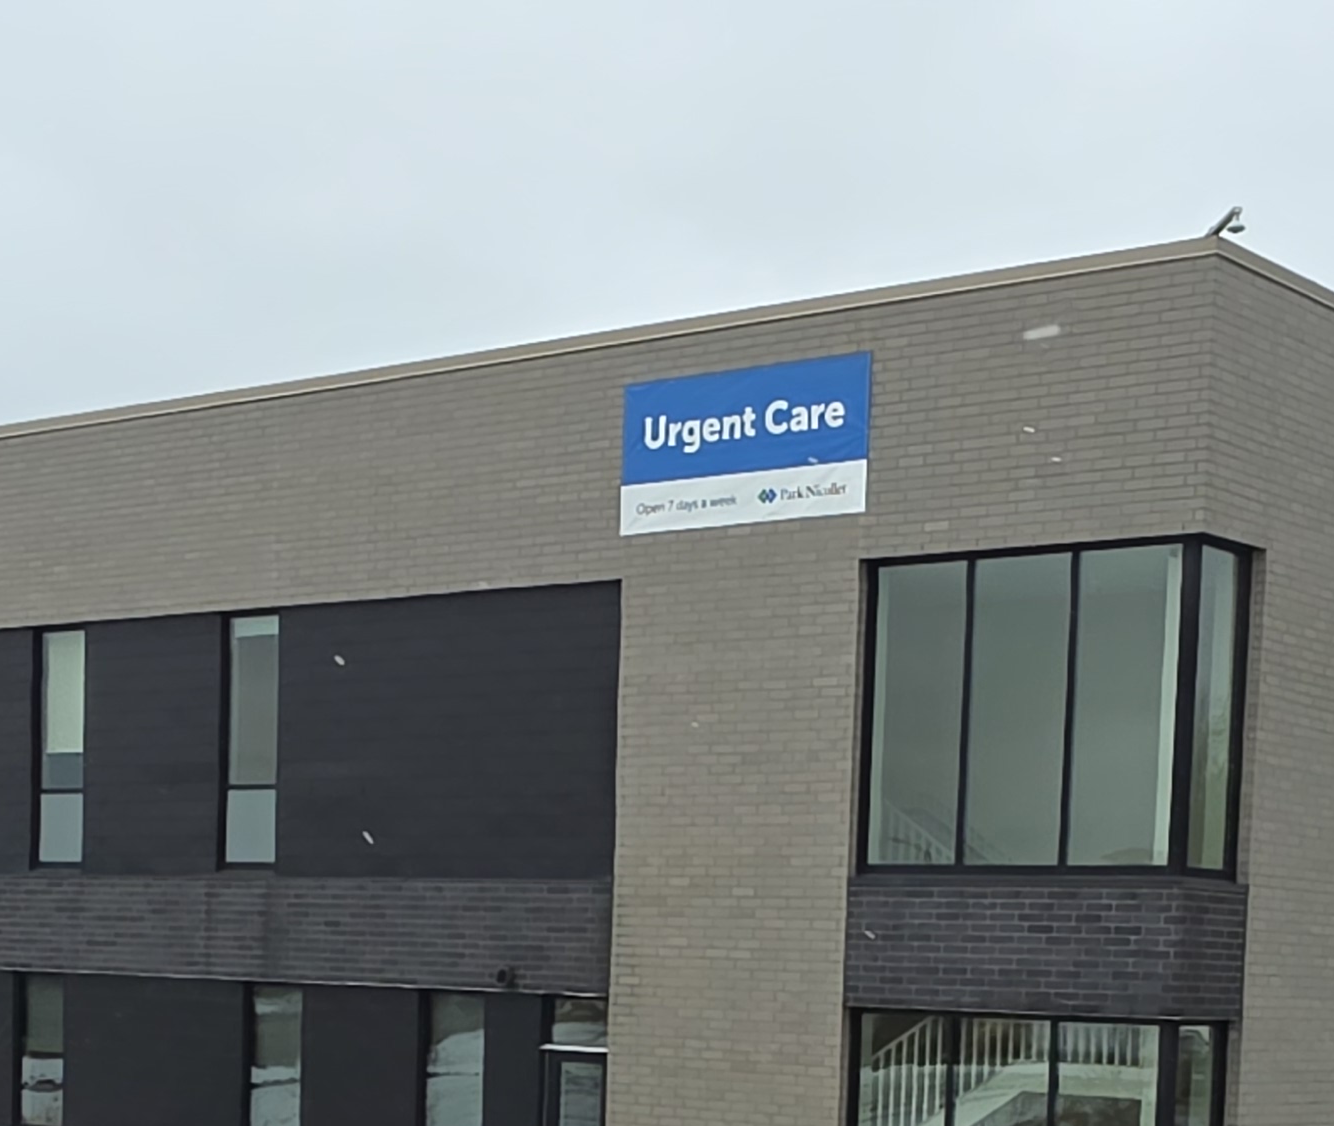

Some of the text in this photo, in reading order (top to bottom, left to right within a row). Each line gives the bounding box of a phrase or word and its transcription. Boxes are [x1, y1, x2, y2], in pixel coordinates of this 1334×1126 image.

[644, 399, 846, 453] Urgent Care
[780, 482, 847, 500] Park Nicollet
[636, 495, 736, 516] Open 7 days a week
